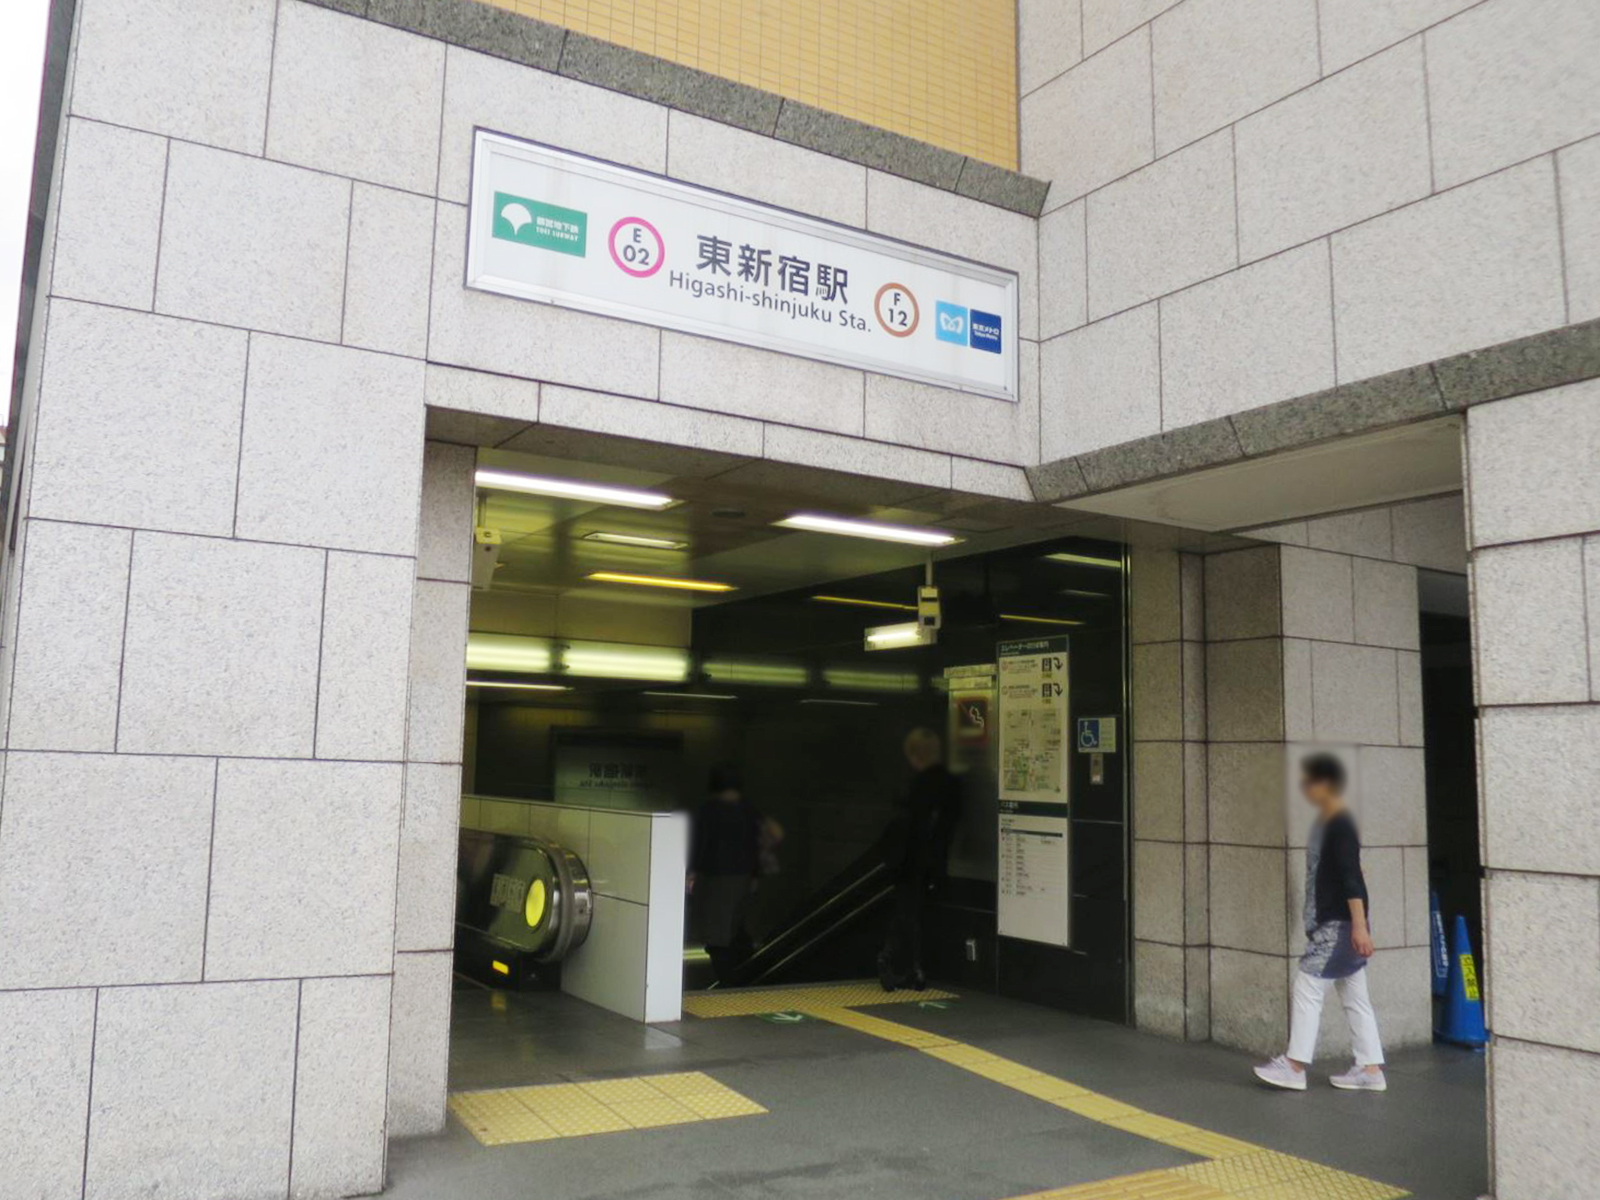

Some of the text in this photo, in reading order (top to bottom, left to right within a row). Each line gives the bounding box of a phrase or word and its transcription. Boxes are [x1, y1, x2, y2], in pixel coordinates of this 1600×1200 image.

[632, 227, 643, 243] E
[622, 244, 651, 266] 02
[695, 234, 849, 305] 東新宿駅
[669, 269, 872, 333] Higashi-shinjuku Sta.
[893, 291, 902, 306] F
[887, 307, 908, 327] 12
